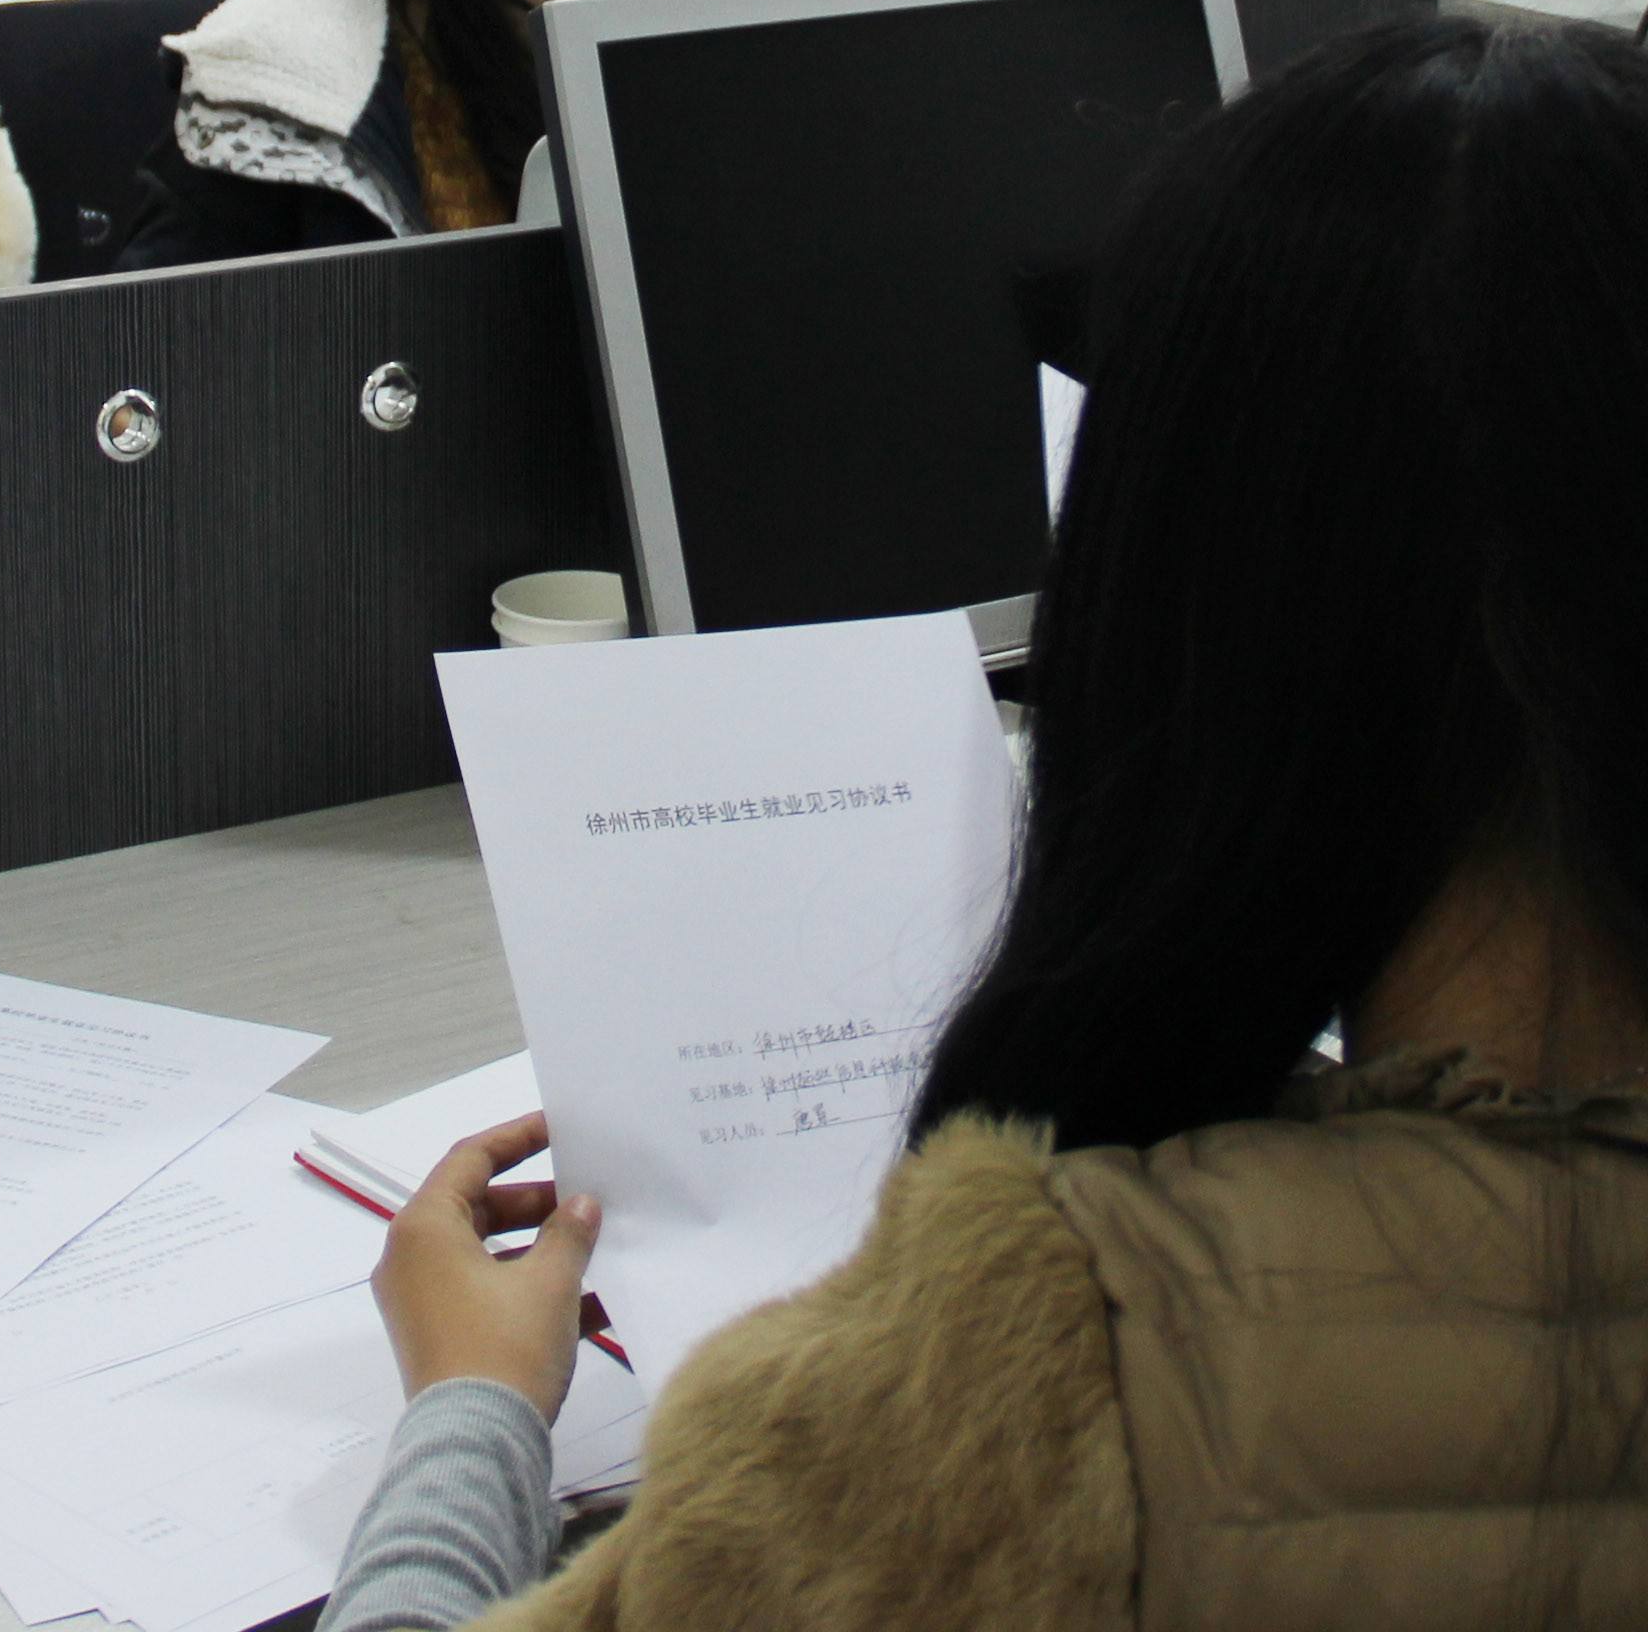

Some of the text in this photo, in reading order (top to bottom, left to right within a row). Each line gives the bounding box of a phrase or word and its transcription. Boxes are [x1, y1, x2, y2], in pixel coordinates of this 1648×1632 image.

[585, 781, 912, 836] 徐州市高校毕业生就业见习协议书
